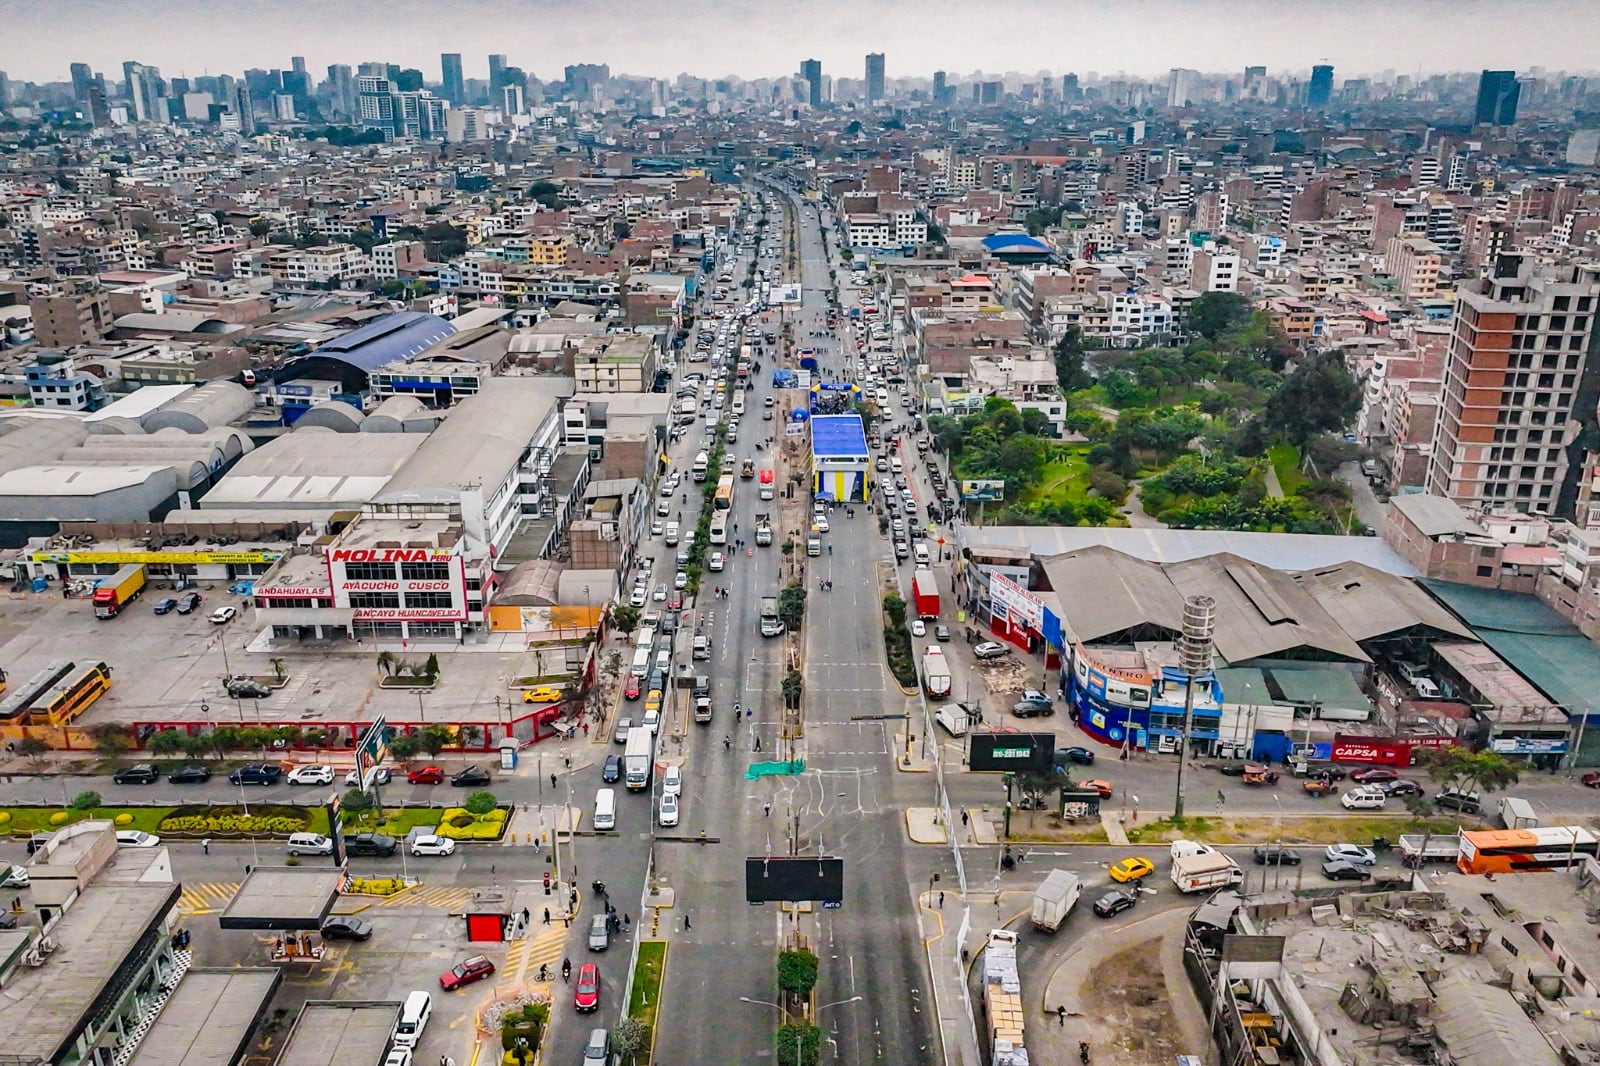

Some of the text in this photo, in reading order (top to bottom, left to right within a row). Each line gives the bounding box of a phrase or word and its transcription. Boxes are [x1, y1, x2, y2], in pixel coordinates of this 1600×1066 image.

[332, 550, 452, 562] MOLINA PERU
[342, 582, 449, 590] AYACUCHO CUSCO
[258, 587, 326, 595] ANDAHUAYLAS
[354, 609, 461, 617] ANCAYO HUANCAVELICA
[1335, 748, 1378, 757] CAPSA
